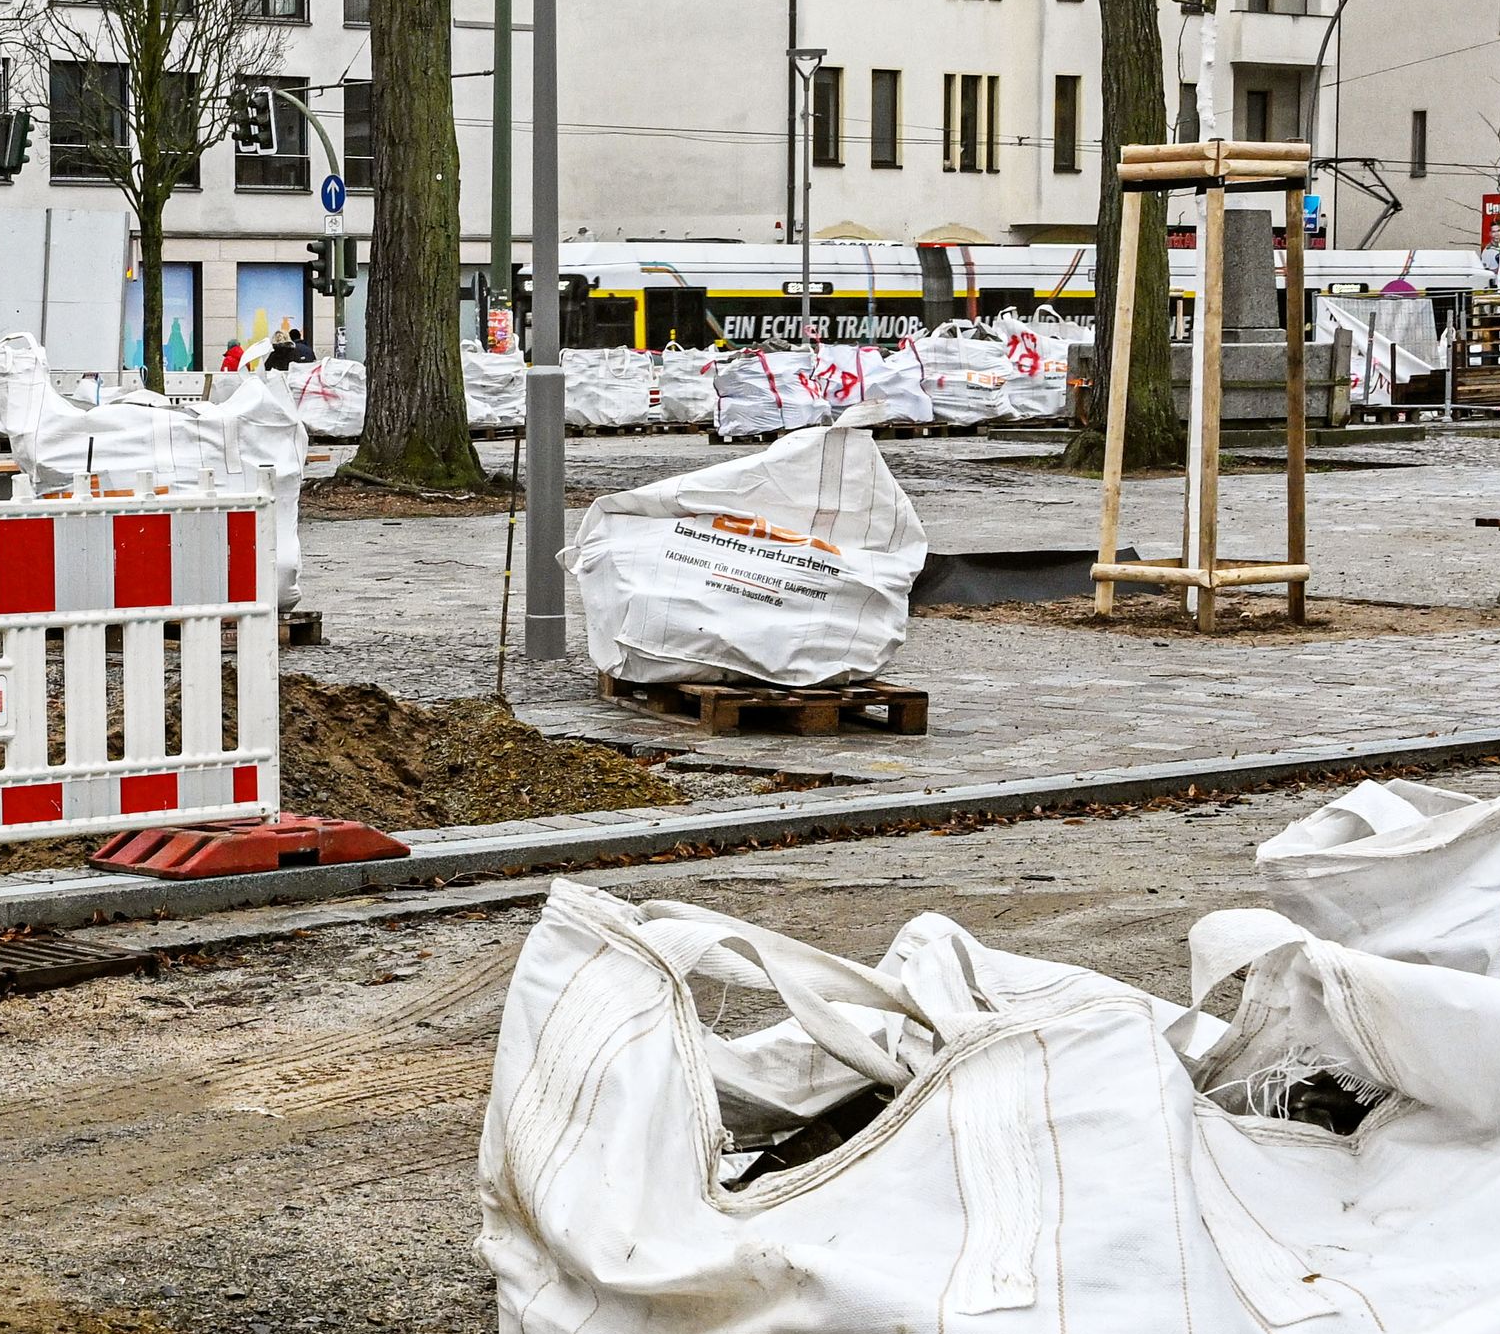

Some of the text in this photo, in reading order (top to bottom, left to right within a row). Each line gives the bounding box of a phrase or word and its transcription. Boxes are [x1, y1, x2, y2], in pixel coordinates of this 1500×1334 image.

[724, 316, 755, 339] EIN
[673, 521, 841, 578] baustoffe+natursteine
[664, 549, 713, 570] FACHHANDEL
[713, 562, 729, 574] FÜR
[783, 580, 829, 602] BAUPROJEKTE
[704, 578, 784, 608] www.raiss-baustoffe.de
